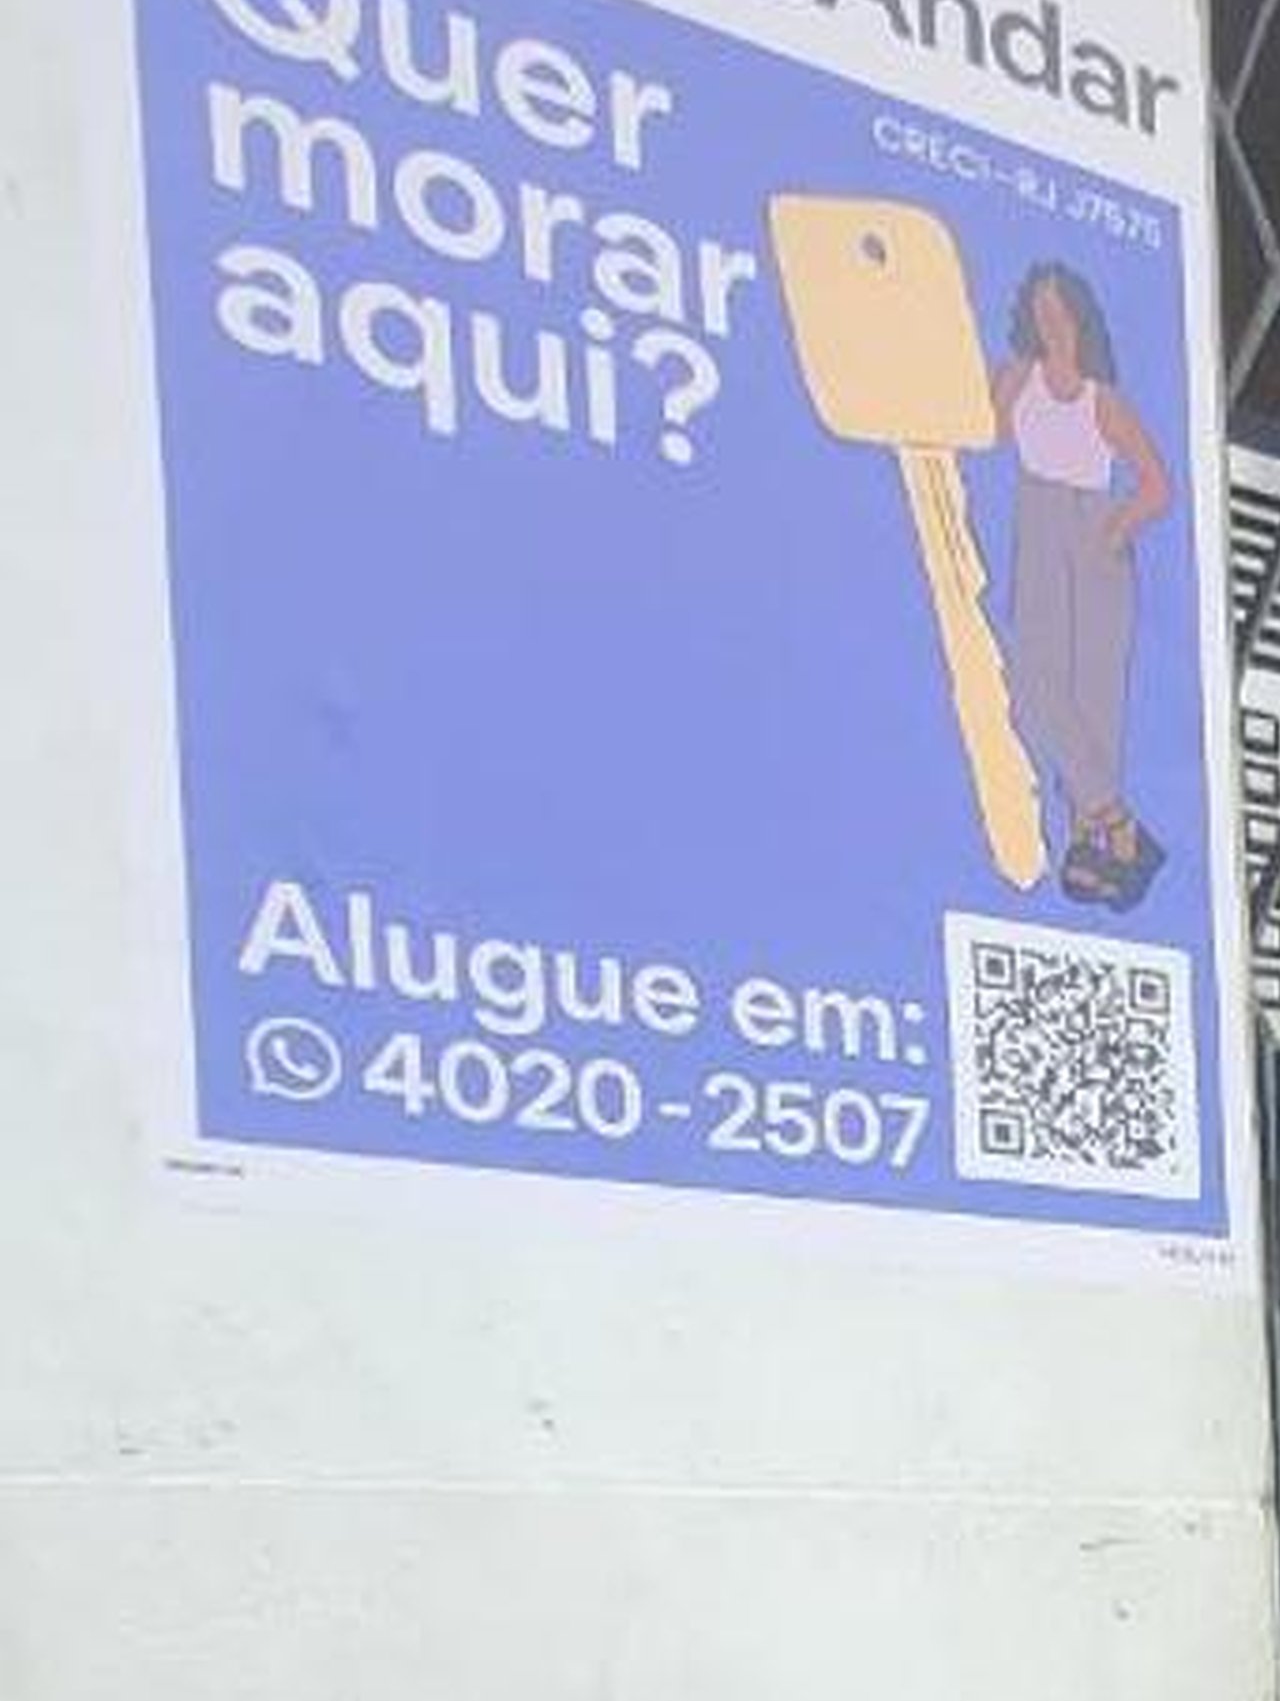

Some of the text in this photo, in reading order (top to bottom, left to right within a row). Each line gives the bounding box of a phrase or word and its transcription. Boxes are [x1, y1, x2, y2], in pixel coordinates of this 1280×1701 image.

[207, 80, 758, 339] morar
[215, 244, 722, 465] aqui?
[239, 879, 930, 1066] Alugue em:
[362, 1031, 931, 1169] 4020-2507
